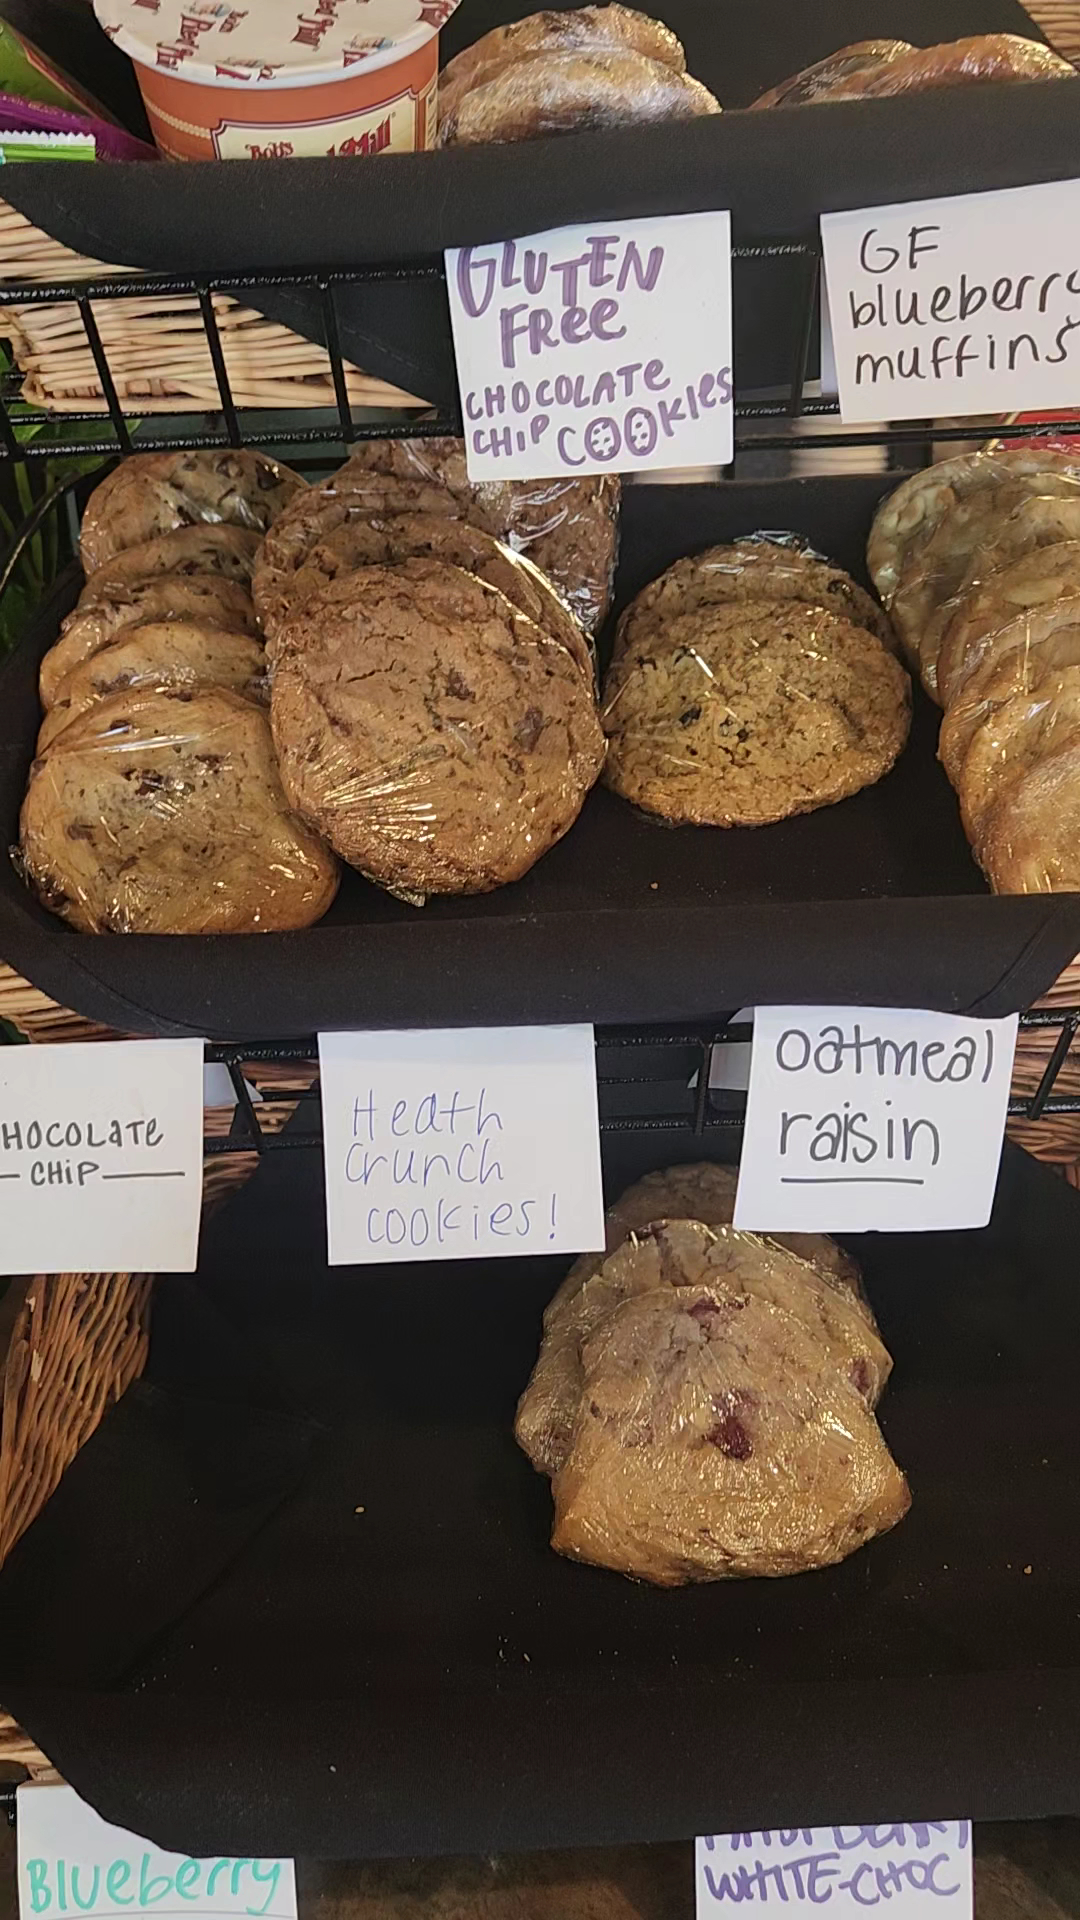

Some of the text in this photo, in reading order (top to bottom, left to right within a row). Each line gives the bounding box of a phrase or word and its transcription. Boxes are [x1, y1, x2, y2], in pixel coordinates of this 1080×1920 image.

[456, 236, 664, 317] GLUTEN
[860, 225, 941, 274] GF
[856, 318, 1080, 384] muffins
[473, 414, 550, 457] CHIP
[776, 1024, 994, 1083] Oatmeal
[353, 1088, 504, 1141] Heath
[780, 1100, 940, 1166] raisin
[26, 1853, 281, 1916] Blueberry
[703, 1852, 961, 1905] WHITE-CHOC
